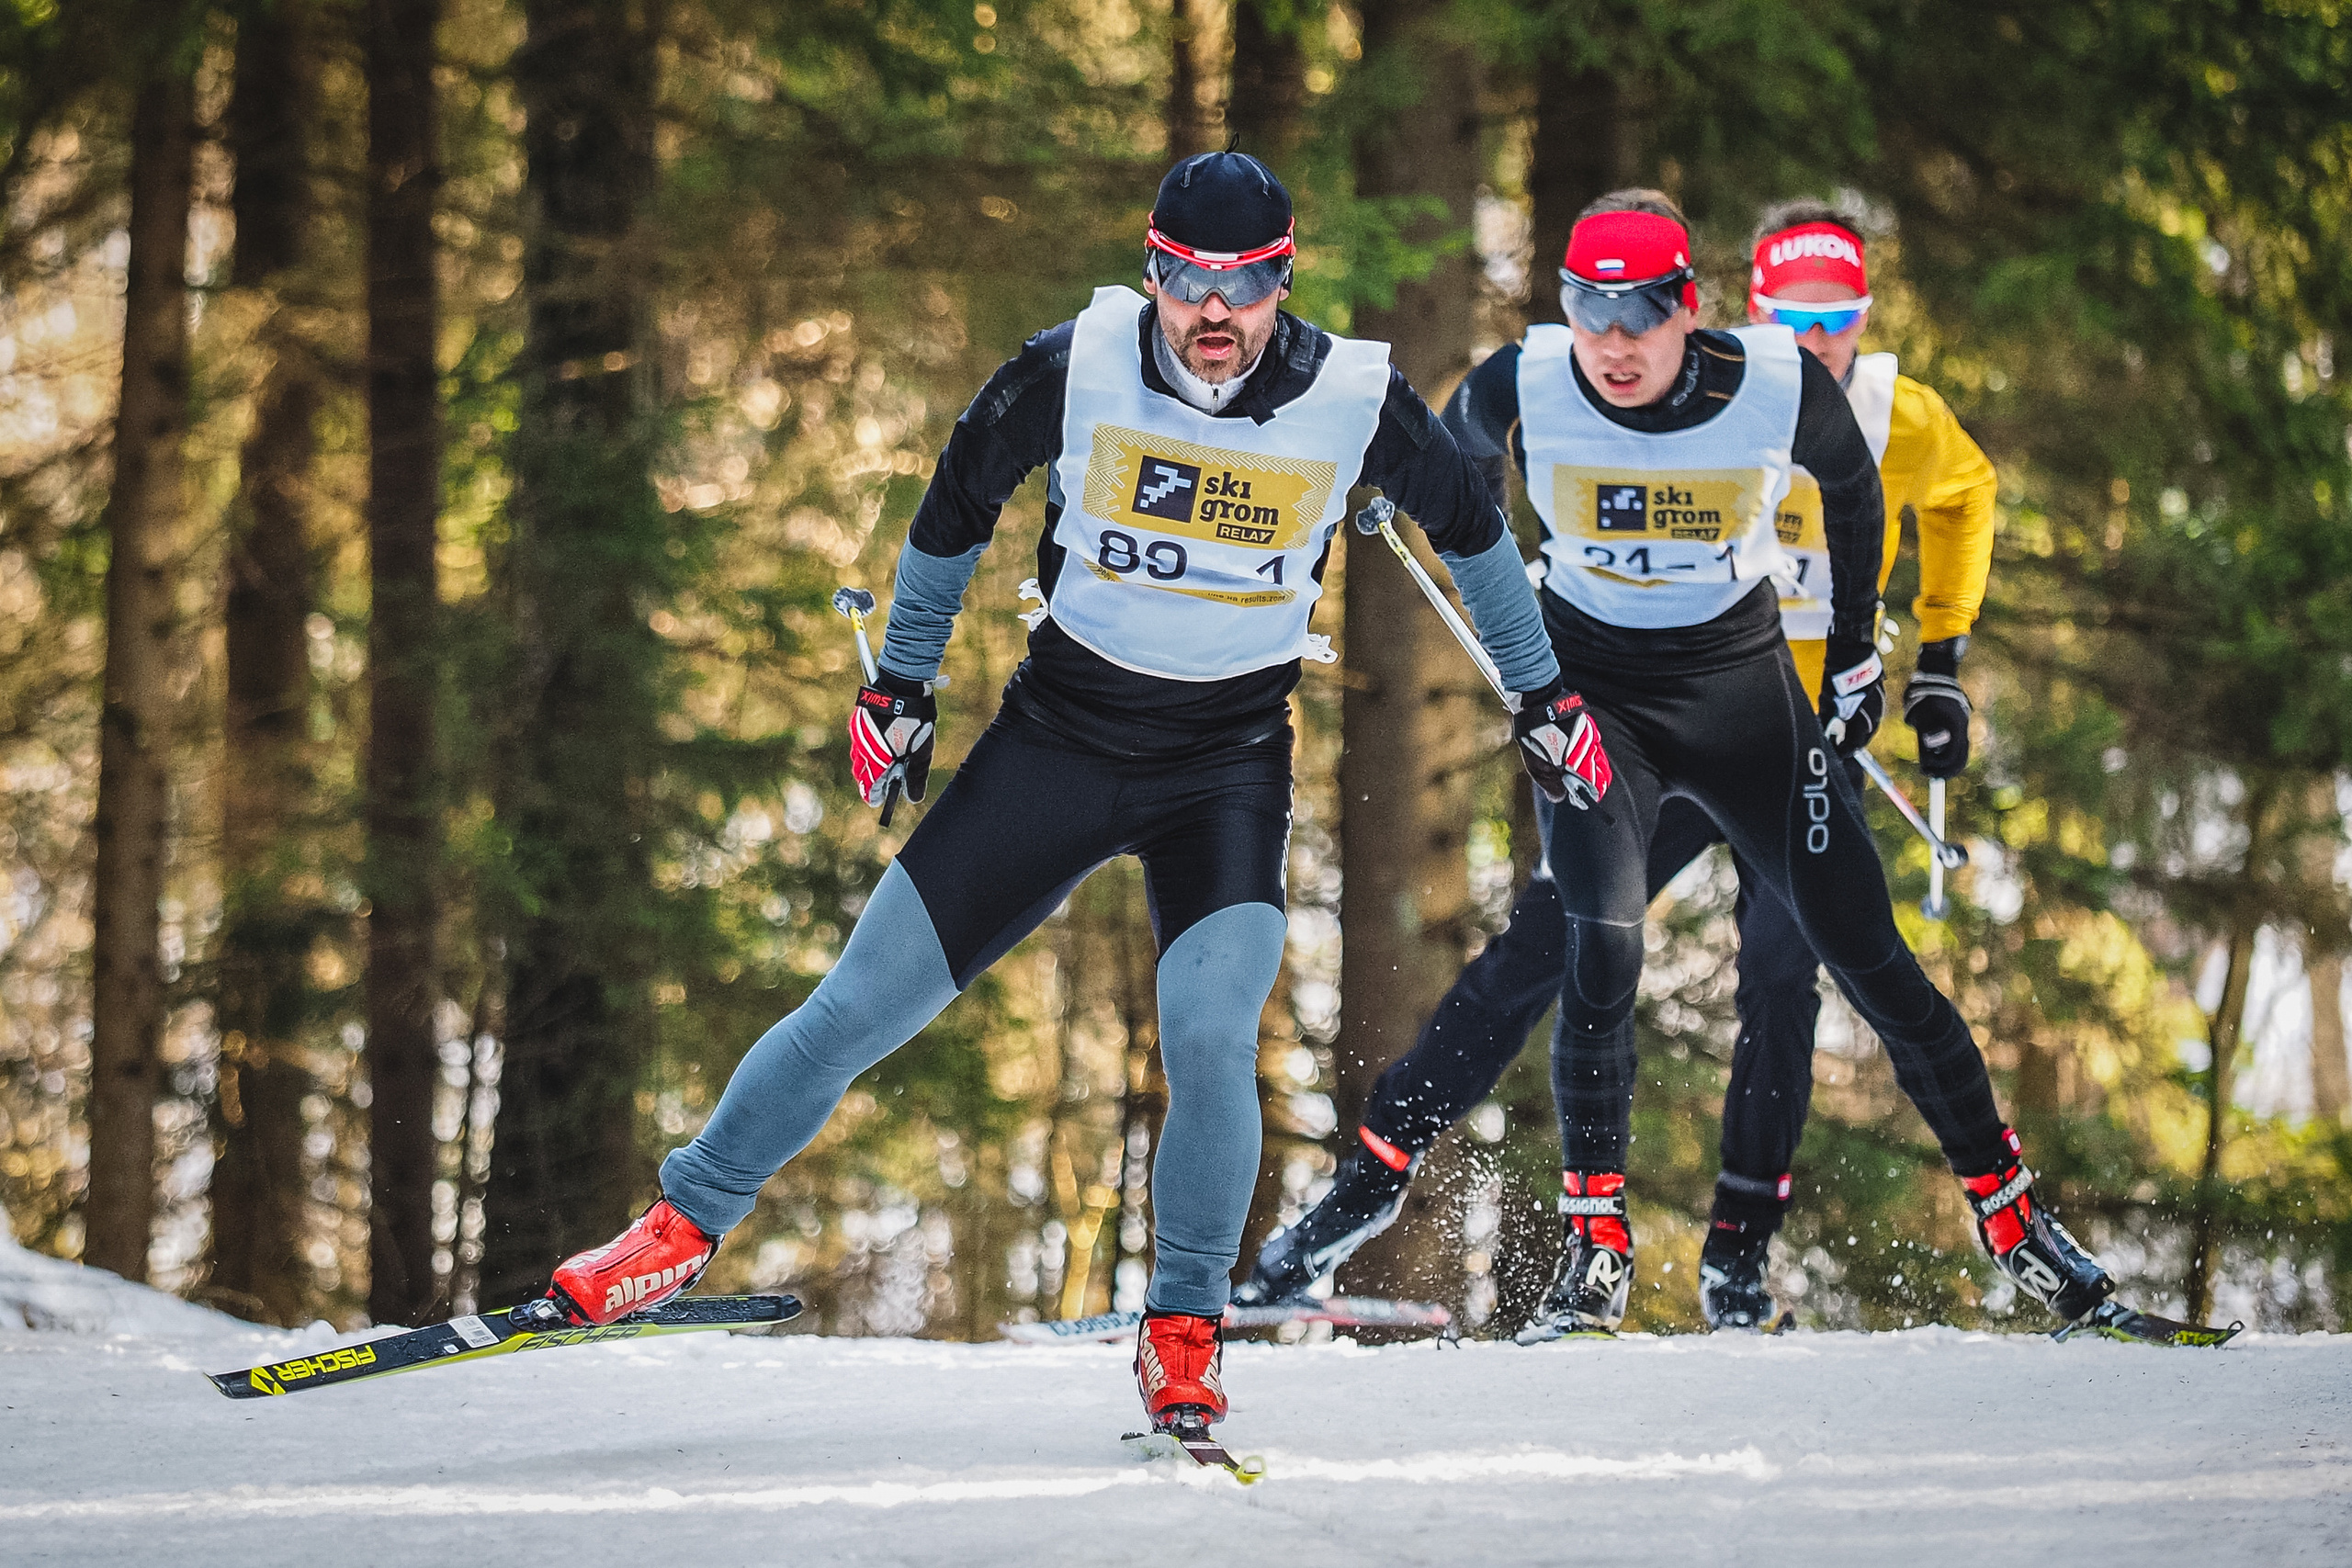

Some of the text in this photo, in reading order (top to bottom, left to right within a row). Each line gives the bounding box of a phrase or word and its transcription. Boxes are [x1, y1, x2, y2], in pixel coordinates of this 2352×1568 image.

[1204, 471, 1251, 500] ski
[1654, 486, 1692, 505] ski
[1199, 499, 1279, 525] grom
[1654, 510, 1721, 528] grom
[1219, 525, 1272, 542] RELAY
[1803, 747, 1830, 854] odlo
[514, 1325, 643, 1353] FISCHER
[273, 1344, 378, 1382] FISCHER
